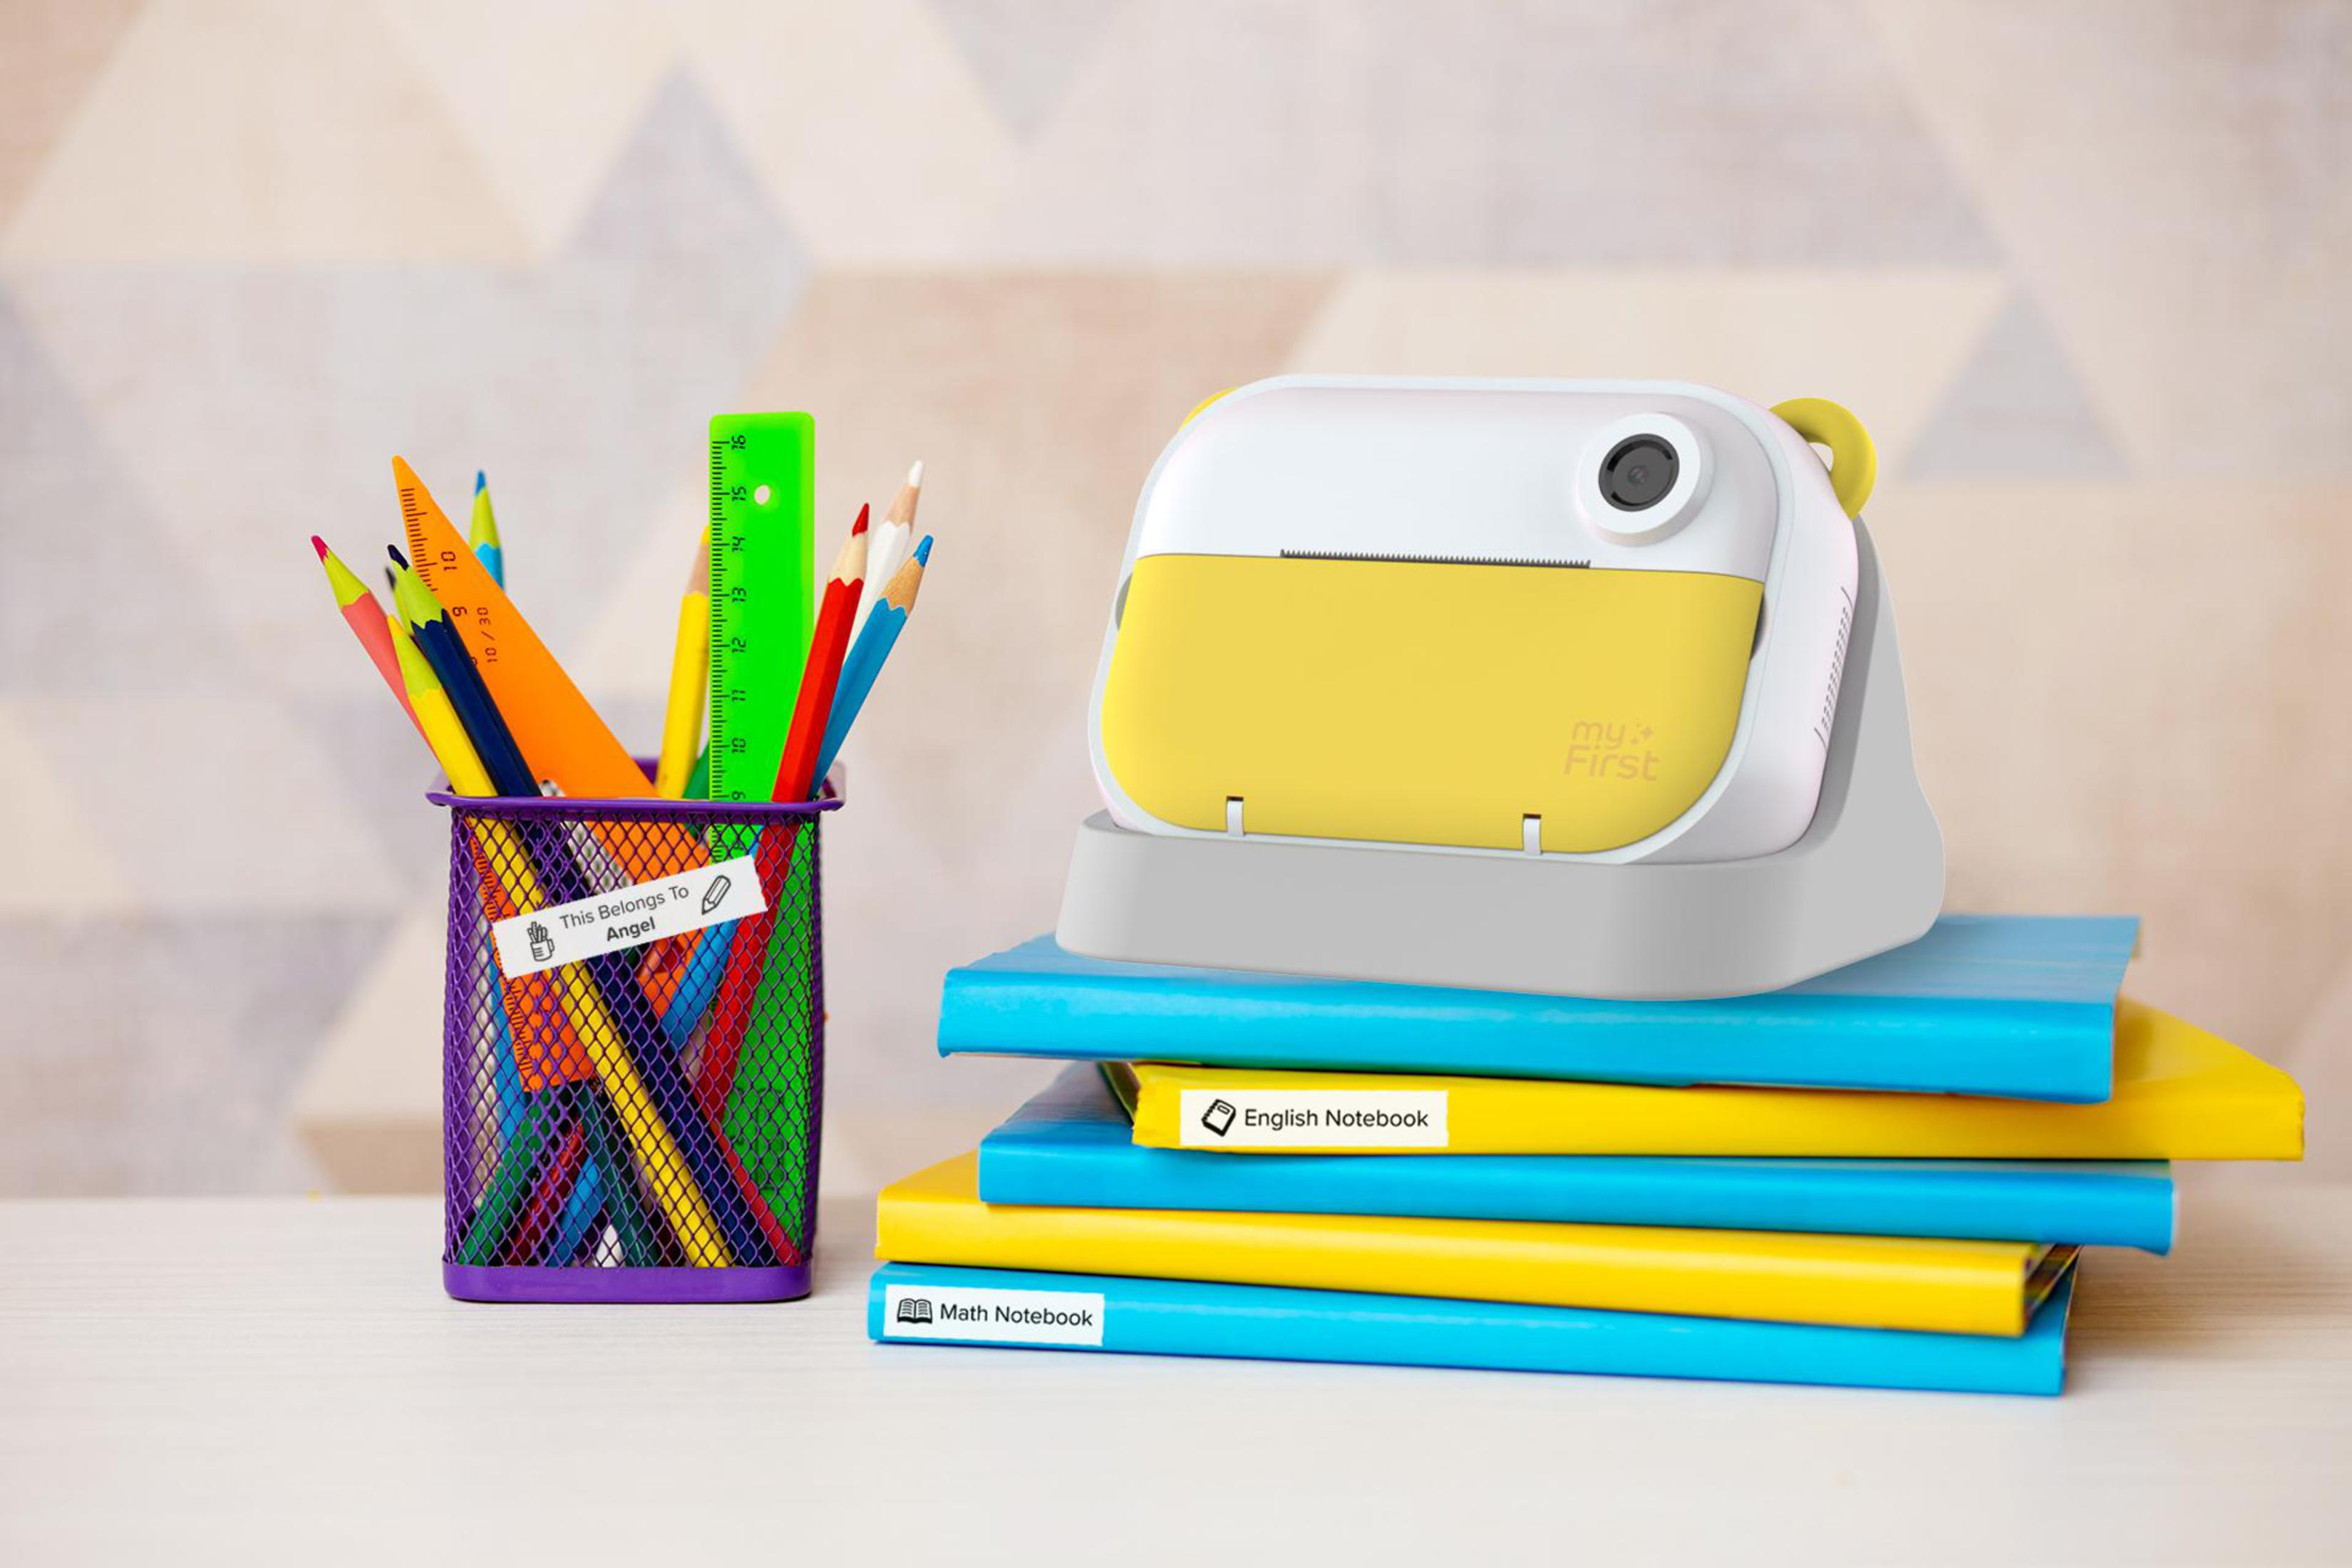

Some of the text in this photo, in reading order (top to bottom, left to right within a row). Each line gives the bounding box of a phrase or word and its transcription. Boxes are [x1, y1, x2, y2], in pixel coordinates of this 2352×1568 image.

[731, 435, 746, 450] 16
[731, 486, 747, 502] 15
[731, 535, 746, 552] 14
[440, 551, 458, 572] 10
[731, 587, 747, 602] 13
[476, 607, 491, 626] 30
[731, 637, 746, 654] 12
[484, 647, 498, 663] 10
[731, 689, 746, 702] 11
[1572, 720, 1626, 750] my
[731, 737, 746, 753] 10
[1563, 744, 1660, 782] First
[559, 885, 689, 929] This Belongs To
[606, 917, 656, 942] Angel
[1244, 1108, 1429, 1131] English Notebook
[940, 1303, 1093, 1326] Math Notebook
